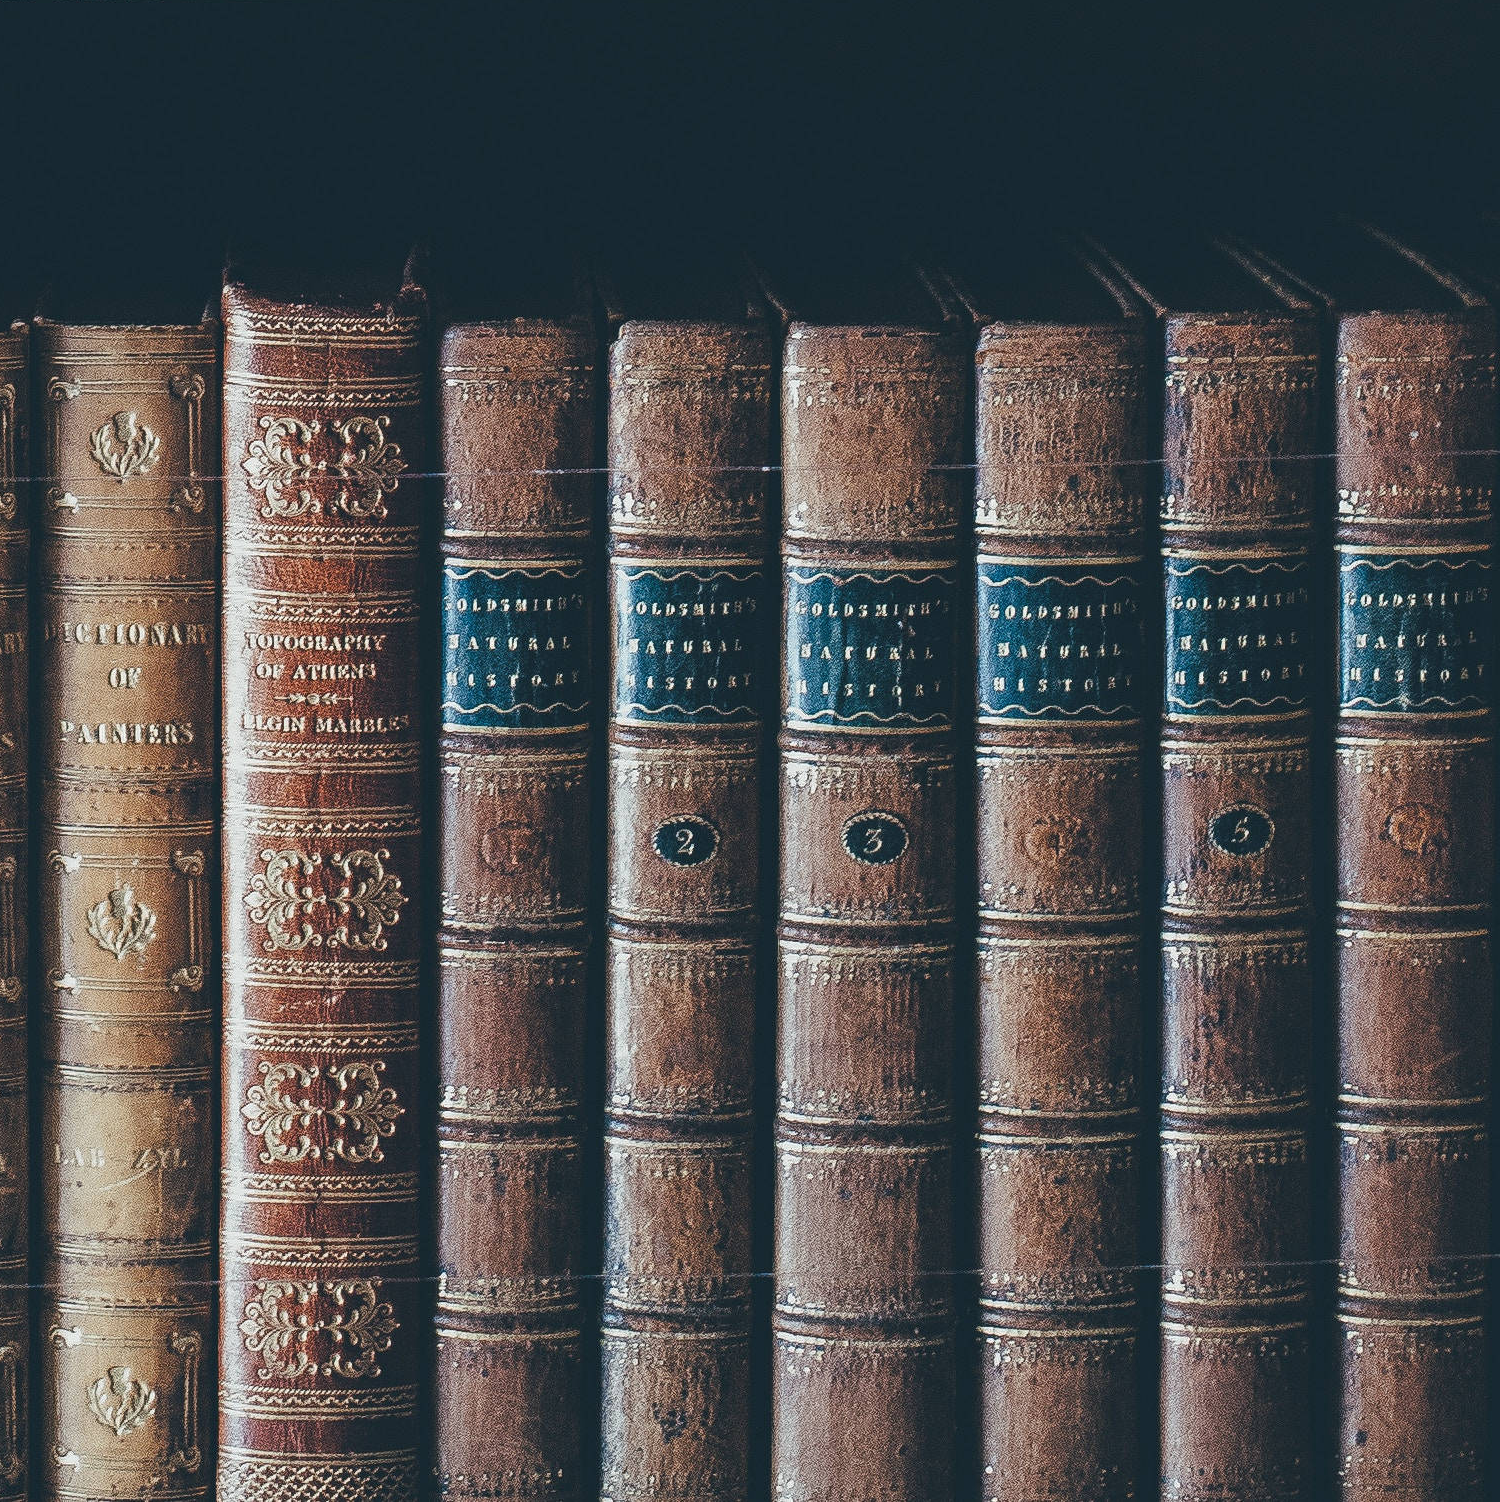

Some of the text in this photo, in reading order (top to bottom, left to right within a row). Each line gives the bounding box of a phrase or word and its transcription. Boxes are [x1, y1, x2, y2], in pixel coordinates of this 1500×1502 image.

[444, 595, 583, 613] GOLDSMITH'S
[1171, 588, 1309, 611] GOLDSMITH'S
[1343, 587, 1488, 608] GOLDSMITH'S
[795, 599, 949, 618] GOLDSMITH'S
[989, 598, 1136, 620] GOLDSMITH'S
[45, 621, 216, 652] DICTIONARY
[245, 632, 386, 653] TOPOGRAPHY
[447, 636, 571, 651] NATURAL
[1181, 633, 1298, 652] NATURAL
[1356, 630, 1476, 649] NATURAL
[629, 638, 742, 655] NATURAL
[801, 643, 933, 661] NATURAL
[998, 642, 1121, 659] NATURAL
[108, 666, 144, 691] OF
[256, 662, 376, 680] OF ATHENS
[446, 671, 579, 688] HISTORY
[1175, 665, 1305, 685] HISTORY
[1350, 663, 1485, 683] HISTORY
[626, 672, 751, 690] HISTORY
[798, 679, 941, 698] HISTORY
[993, 675, 1132, 692] HISTORY
[59, 720, 195, 746] PAINTERS
[243, 715, 411, 734] ELGIN MARBLES
[675, 829, 696, 856] 2
[863, 827, 883, 855] 3
